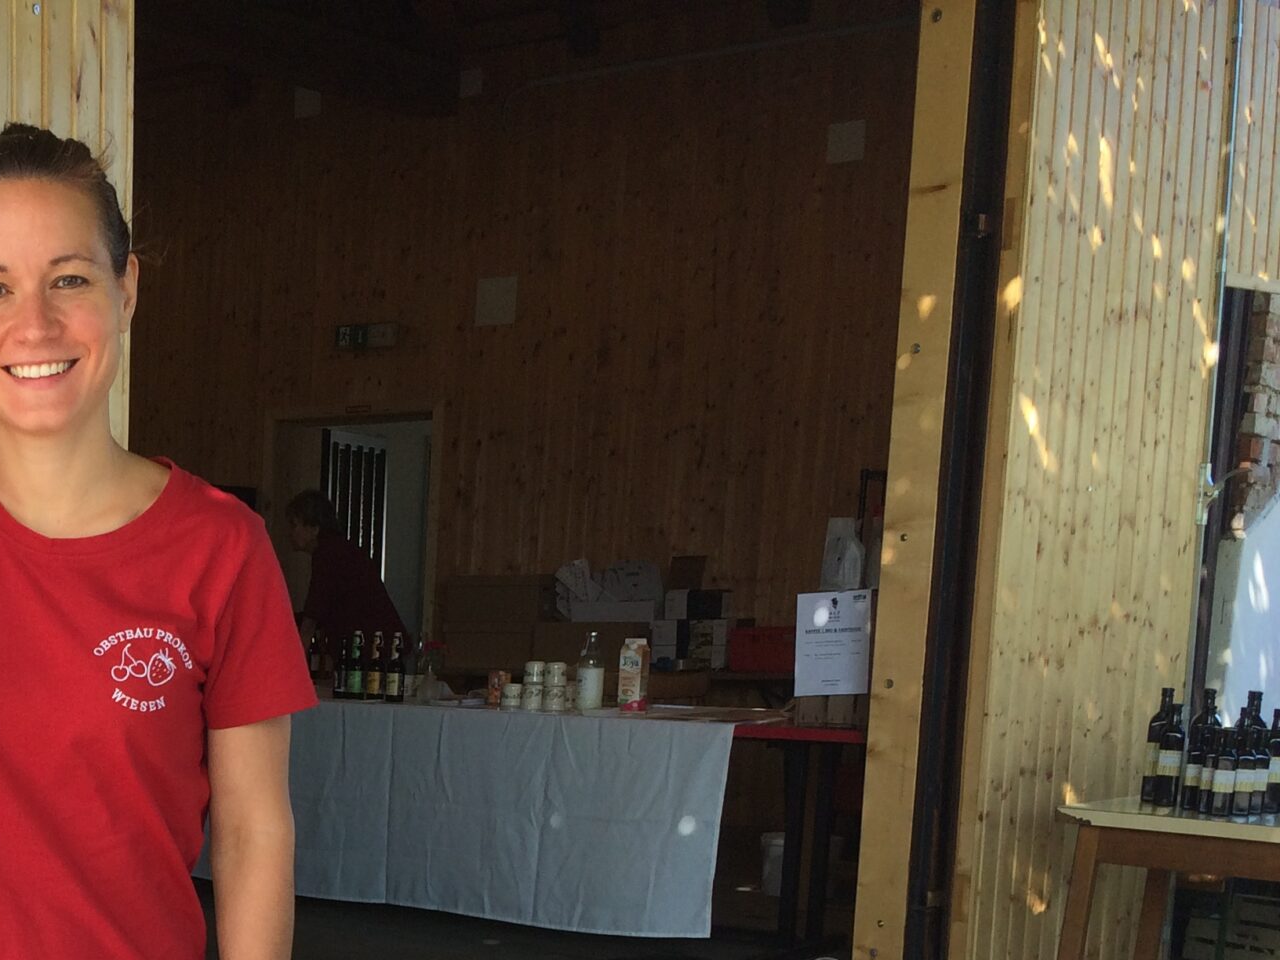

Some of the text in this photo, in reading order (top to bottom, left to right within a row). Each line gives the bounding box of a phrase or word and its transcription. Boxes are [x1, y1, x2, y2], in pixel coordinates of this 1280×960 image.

[93, 627, 193, 670] OBSTBAU PROKOP
[111, 687, 166, 712] WIESEN
